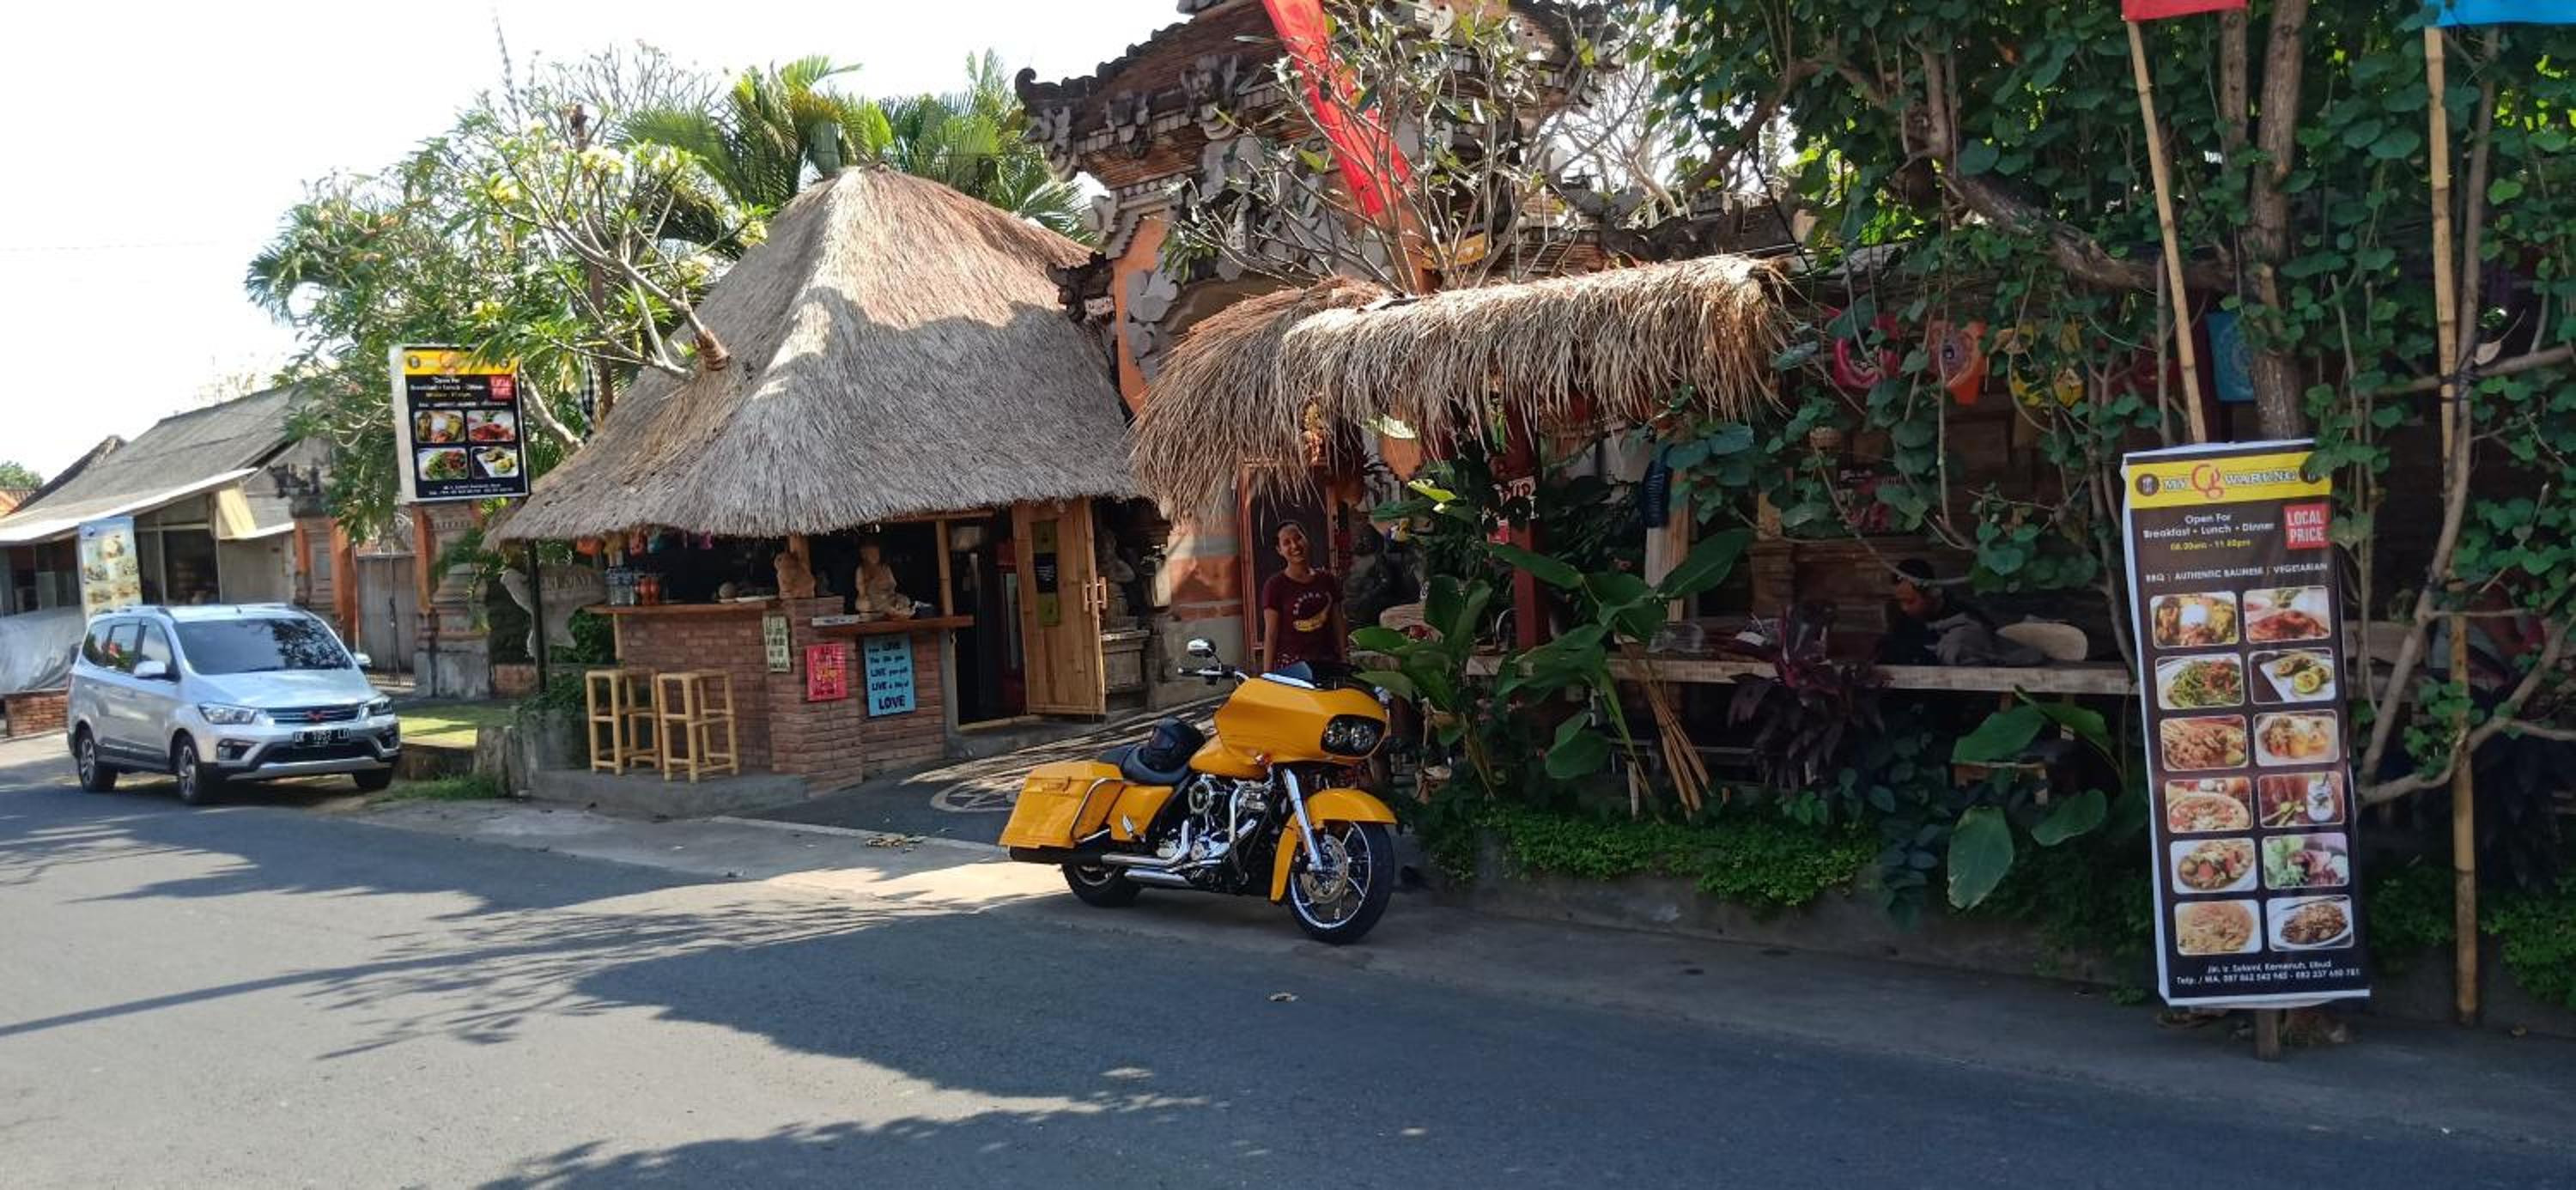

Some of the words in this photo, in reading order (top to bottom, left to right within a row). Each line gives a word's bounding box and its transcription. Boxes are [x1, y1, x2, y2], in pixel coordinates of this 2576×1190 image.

[2225, 468, 2299, 485] WARUNG
[2184, 514, 2214, 525] Open
[2216, 513, 2231, 522] For
[2287, 510, 2324, 526] LOCAL
[2142, 527, 2191, 539] Breakfast
[2201, 525, 2232, 535] Lunch
[2242, 522, 2275, 531] Dinner
[2289, 526, 2325, 543] PRICE
[2175, 569, 2221, 580] AUTHENTIC
[2224, 567, 2264, 578] BALINESE
[2274, 562, 2328, 574] VEGETARIAN
[878, 695, 906, 710] LOVE
